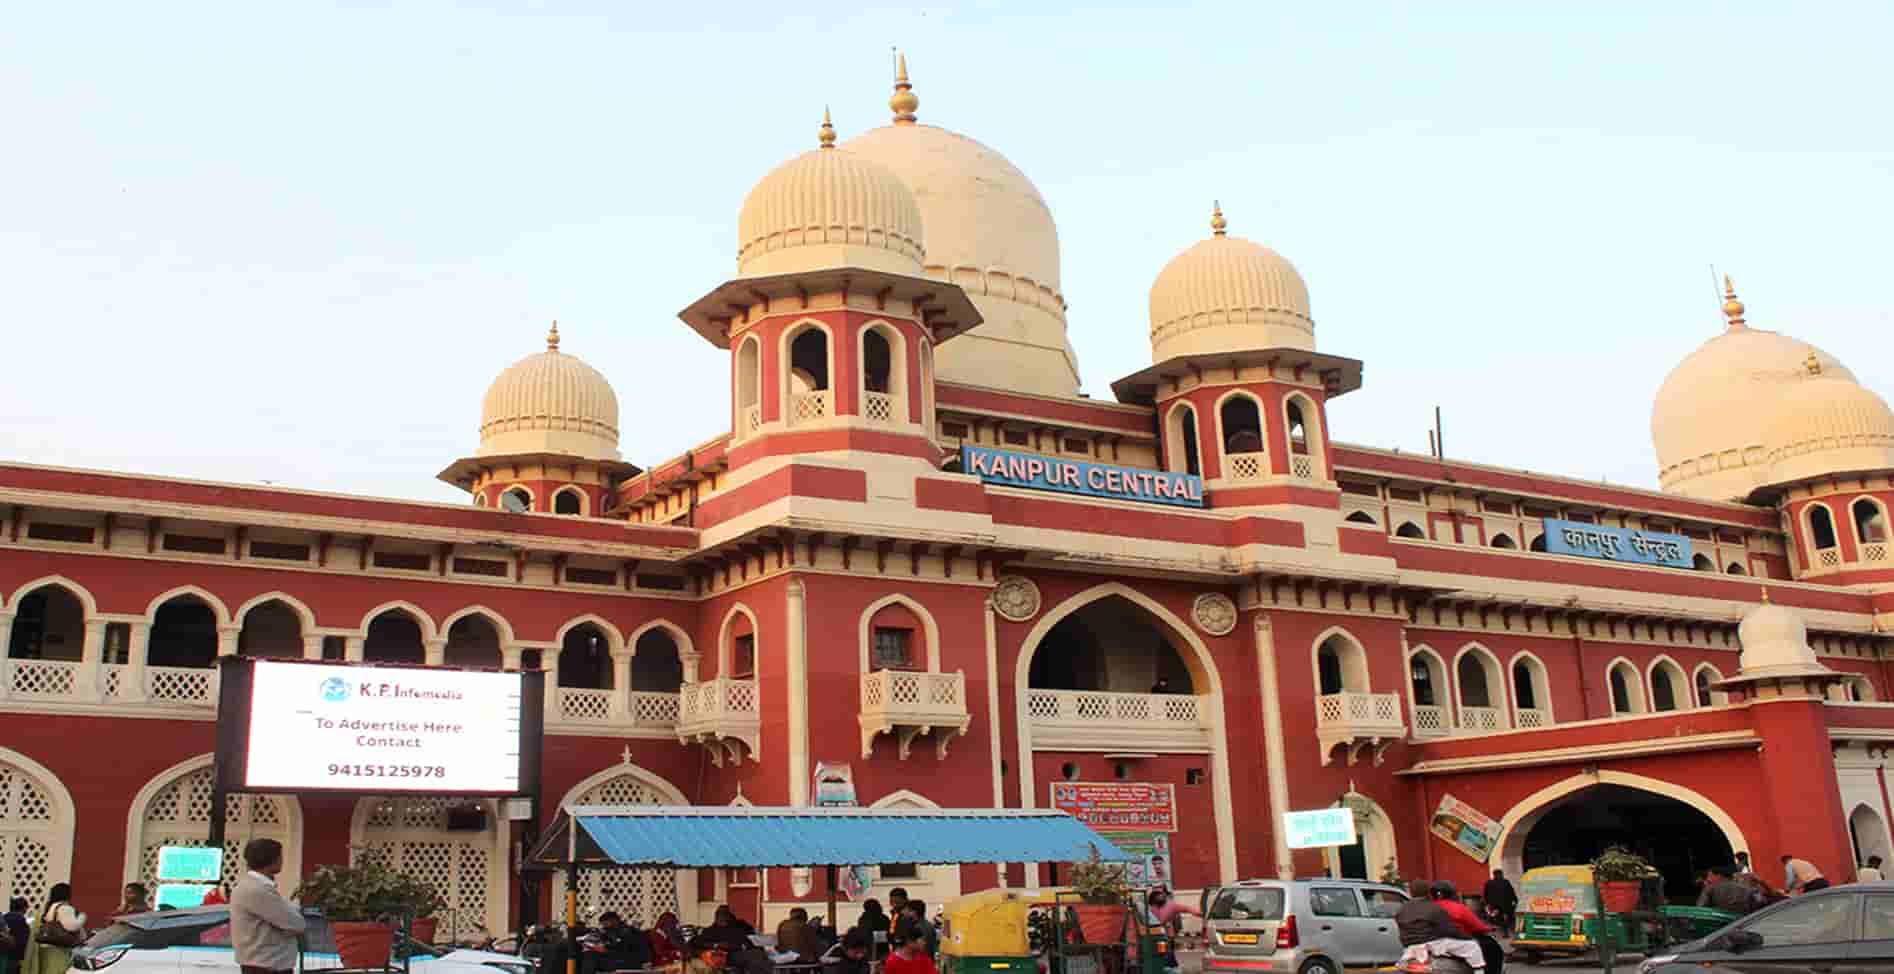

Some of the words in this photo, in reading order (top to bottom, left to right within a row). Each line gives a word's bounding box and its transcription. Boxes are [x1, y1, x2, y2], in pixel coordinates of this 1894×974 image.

[970, 450, 1081, 489] KANPUR
[1087, 467, 1202, 501] CENTRAL
[1562, 527, 1623, 560] कानपुर
[314, 717, 334, 730] To
[338, 718, 420, 733] Advertise
[423, 721, 464, 734] Here
[355, 735, 423, 749] Contact
[327, 763, 447, 779] 9415125978
